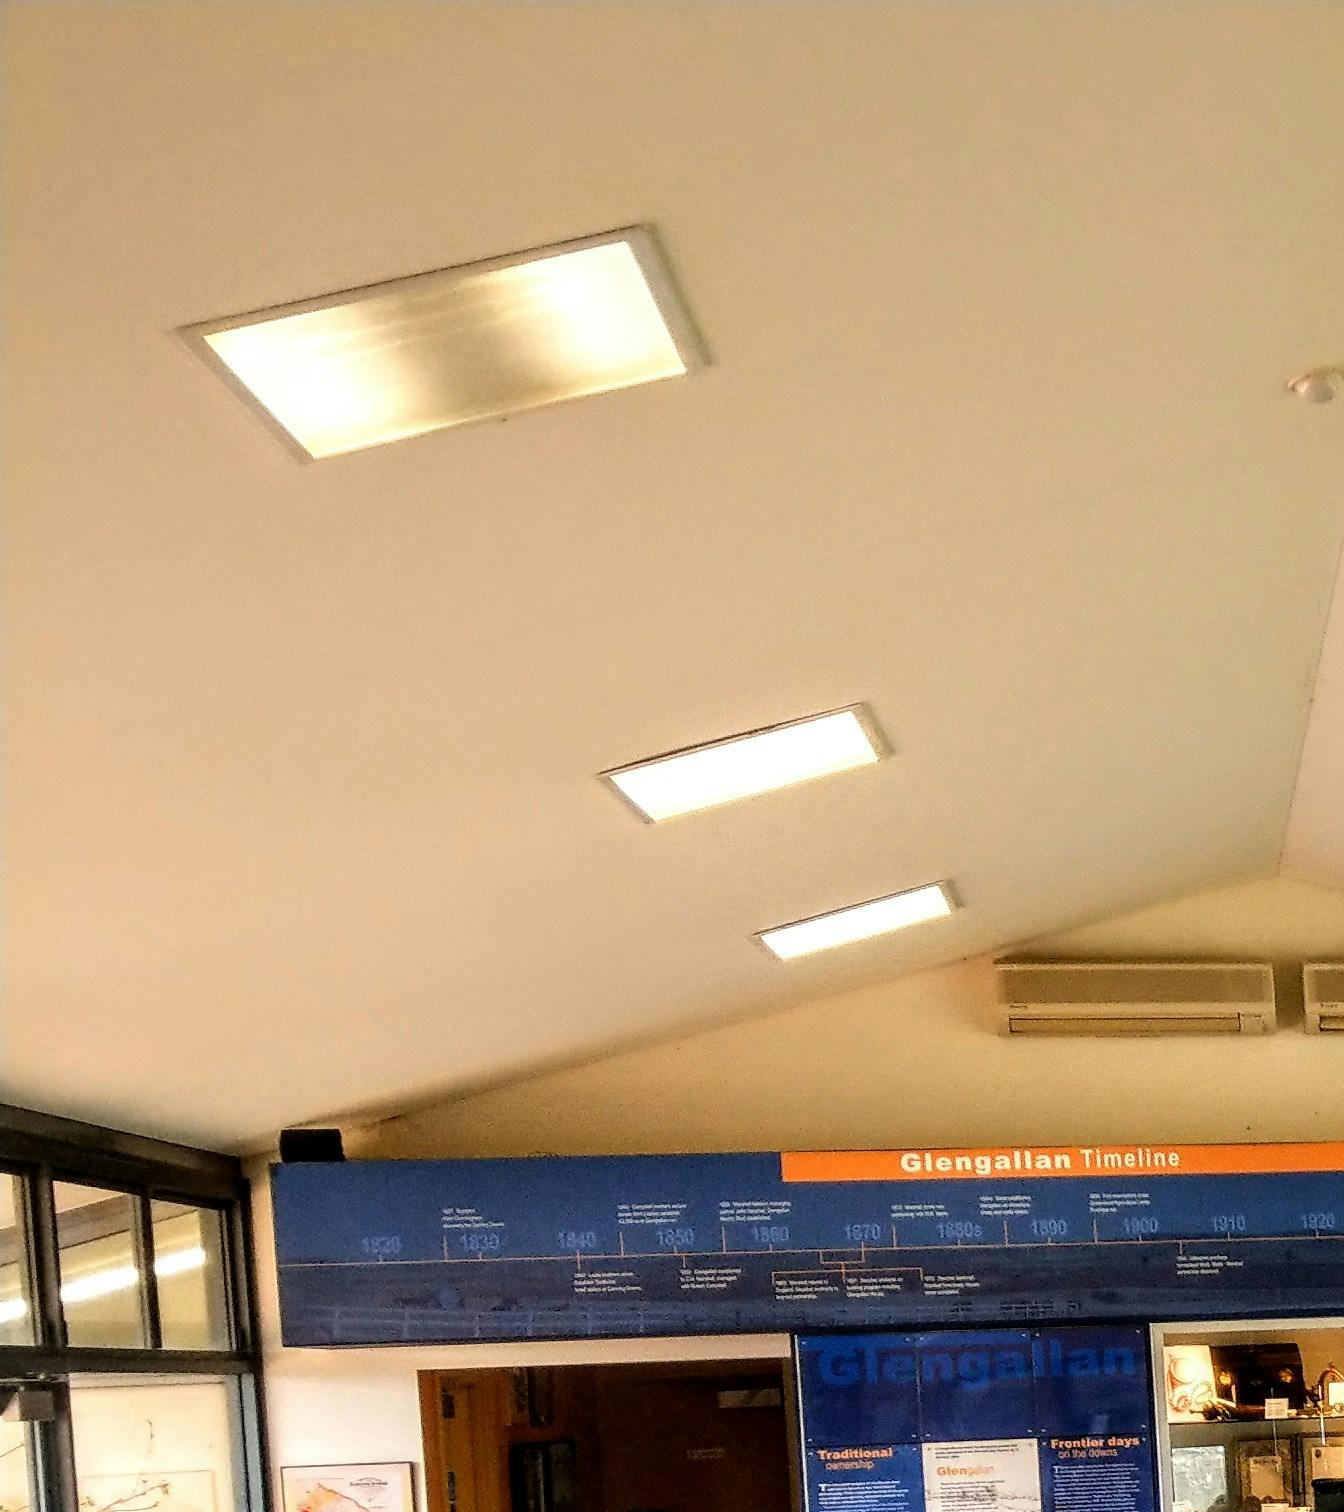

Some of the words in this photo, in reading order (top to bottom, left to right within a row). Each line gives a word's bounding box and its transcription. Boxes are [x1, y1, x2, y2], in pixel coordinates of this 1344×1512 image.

[900, 1150, 1071, 1175] Glengallan
[1080, 1148, 1180, 1169] Timeline
[937, 1221, 983, 1238] 1880s
[1032, 1218, 1067, 1235] 1890
[1124, 1217, 1158, 1233] 1900
[1212, 1215, 1247, 1232] 1910
[1302, 1213, 1335, 1229] 1920
[558, 1230, 597, 1248] 1840
[657, 1226, 697, 1245] 1850
[753, 1225, 790, 1242] 1860
[846, 1222, 882, 1241] 1870
[818, 1338, 1136, 1391] Glengallan
[1050, 1438, 1104, 1449] Frontier
[1107, 1436, 1140, 1448] days
[817, 1448, 892, 1460] Traditional
